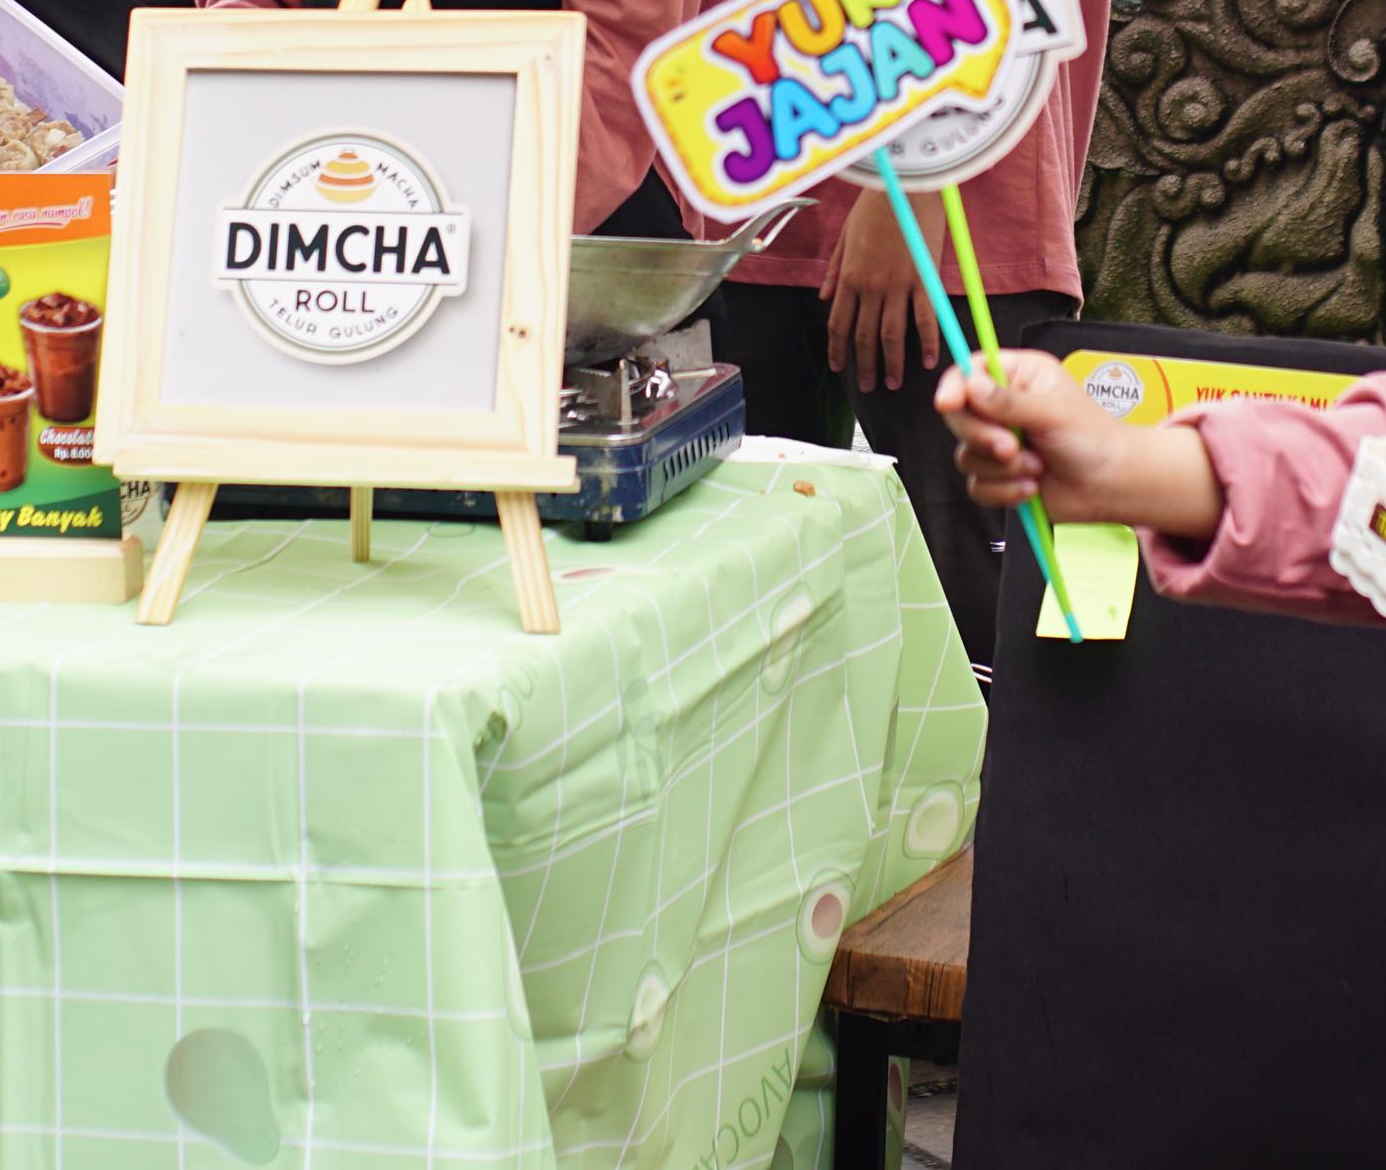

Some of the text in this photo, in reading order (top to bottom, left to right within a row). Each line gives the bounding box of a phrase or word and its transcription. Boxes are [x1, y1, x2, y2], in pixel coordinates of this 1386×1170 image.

[268, 160, 419, 208] DIMSUM MACHA
[226, 221, 451, 275] DIMCHA
[295, 289, 375, 313] ROLL
[268, 298, 399, 339] TELUR GULUNG
[1086, 383, 1140, 401] DIMCHA
[40, 429, 95, 446] Chocolat
[16, 505, 104, 533] Banyak
